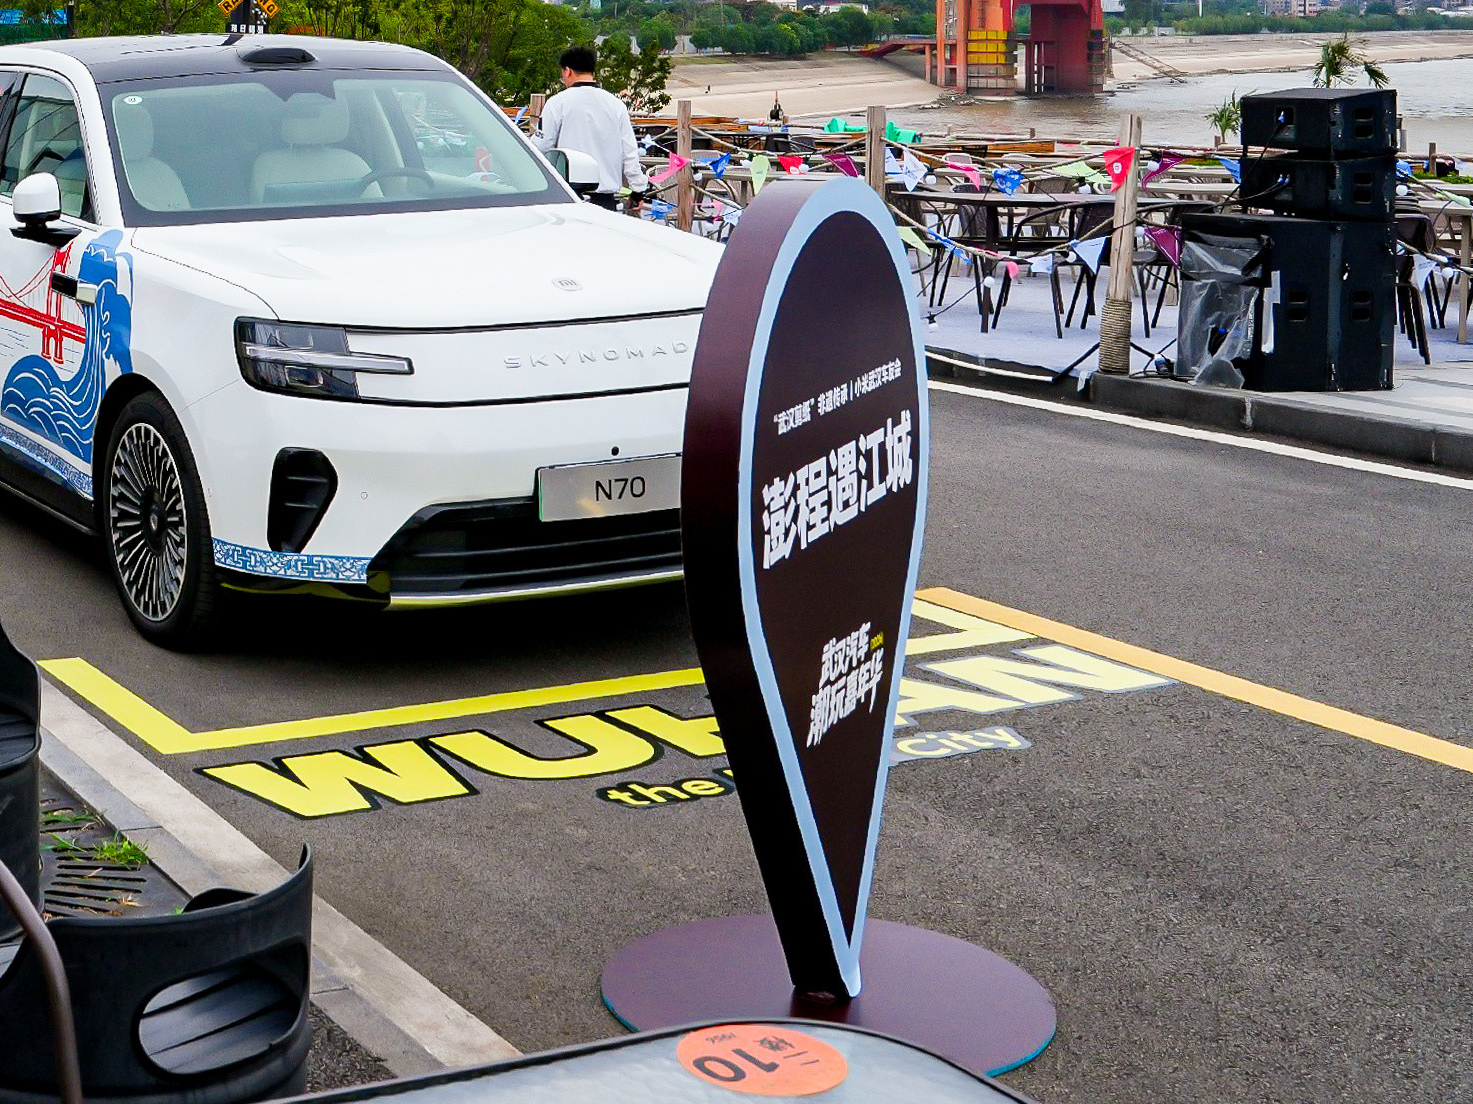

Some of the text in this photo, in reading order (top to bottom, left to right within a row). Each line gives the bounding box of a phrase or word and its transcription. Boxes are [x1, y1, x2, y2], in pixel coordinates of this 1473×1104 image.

[503, 342, 688, 369] SKYNOMAD
[594, 475, 646, 502] N70
[762, 409, 913, 570] 澎程遇江城
[818, 621, 871, 689] 武汉汽车
[806, 647, 884, 748] 潮玩嘉年华
[606, 728, 1022, 806] the City
[692, 1048, 780, 1083] 10
